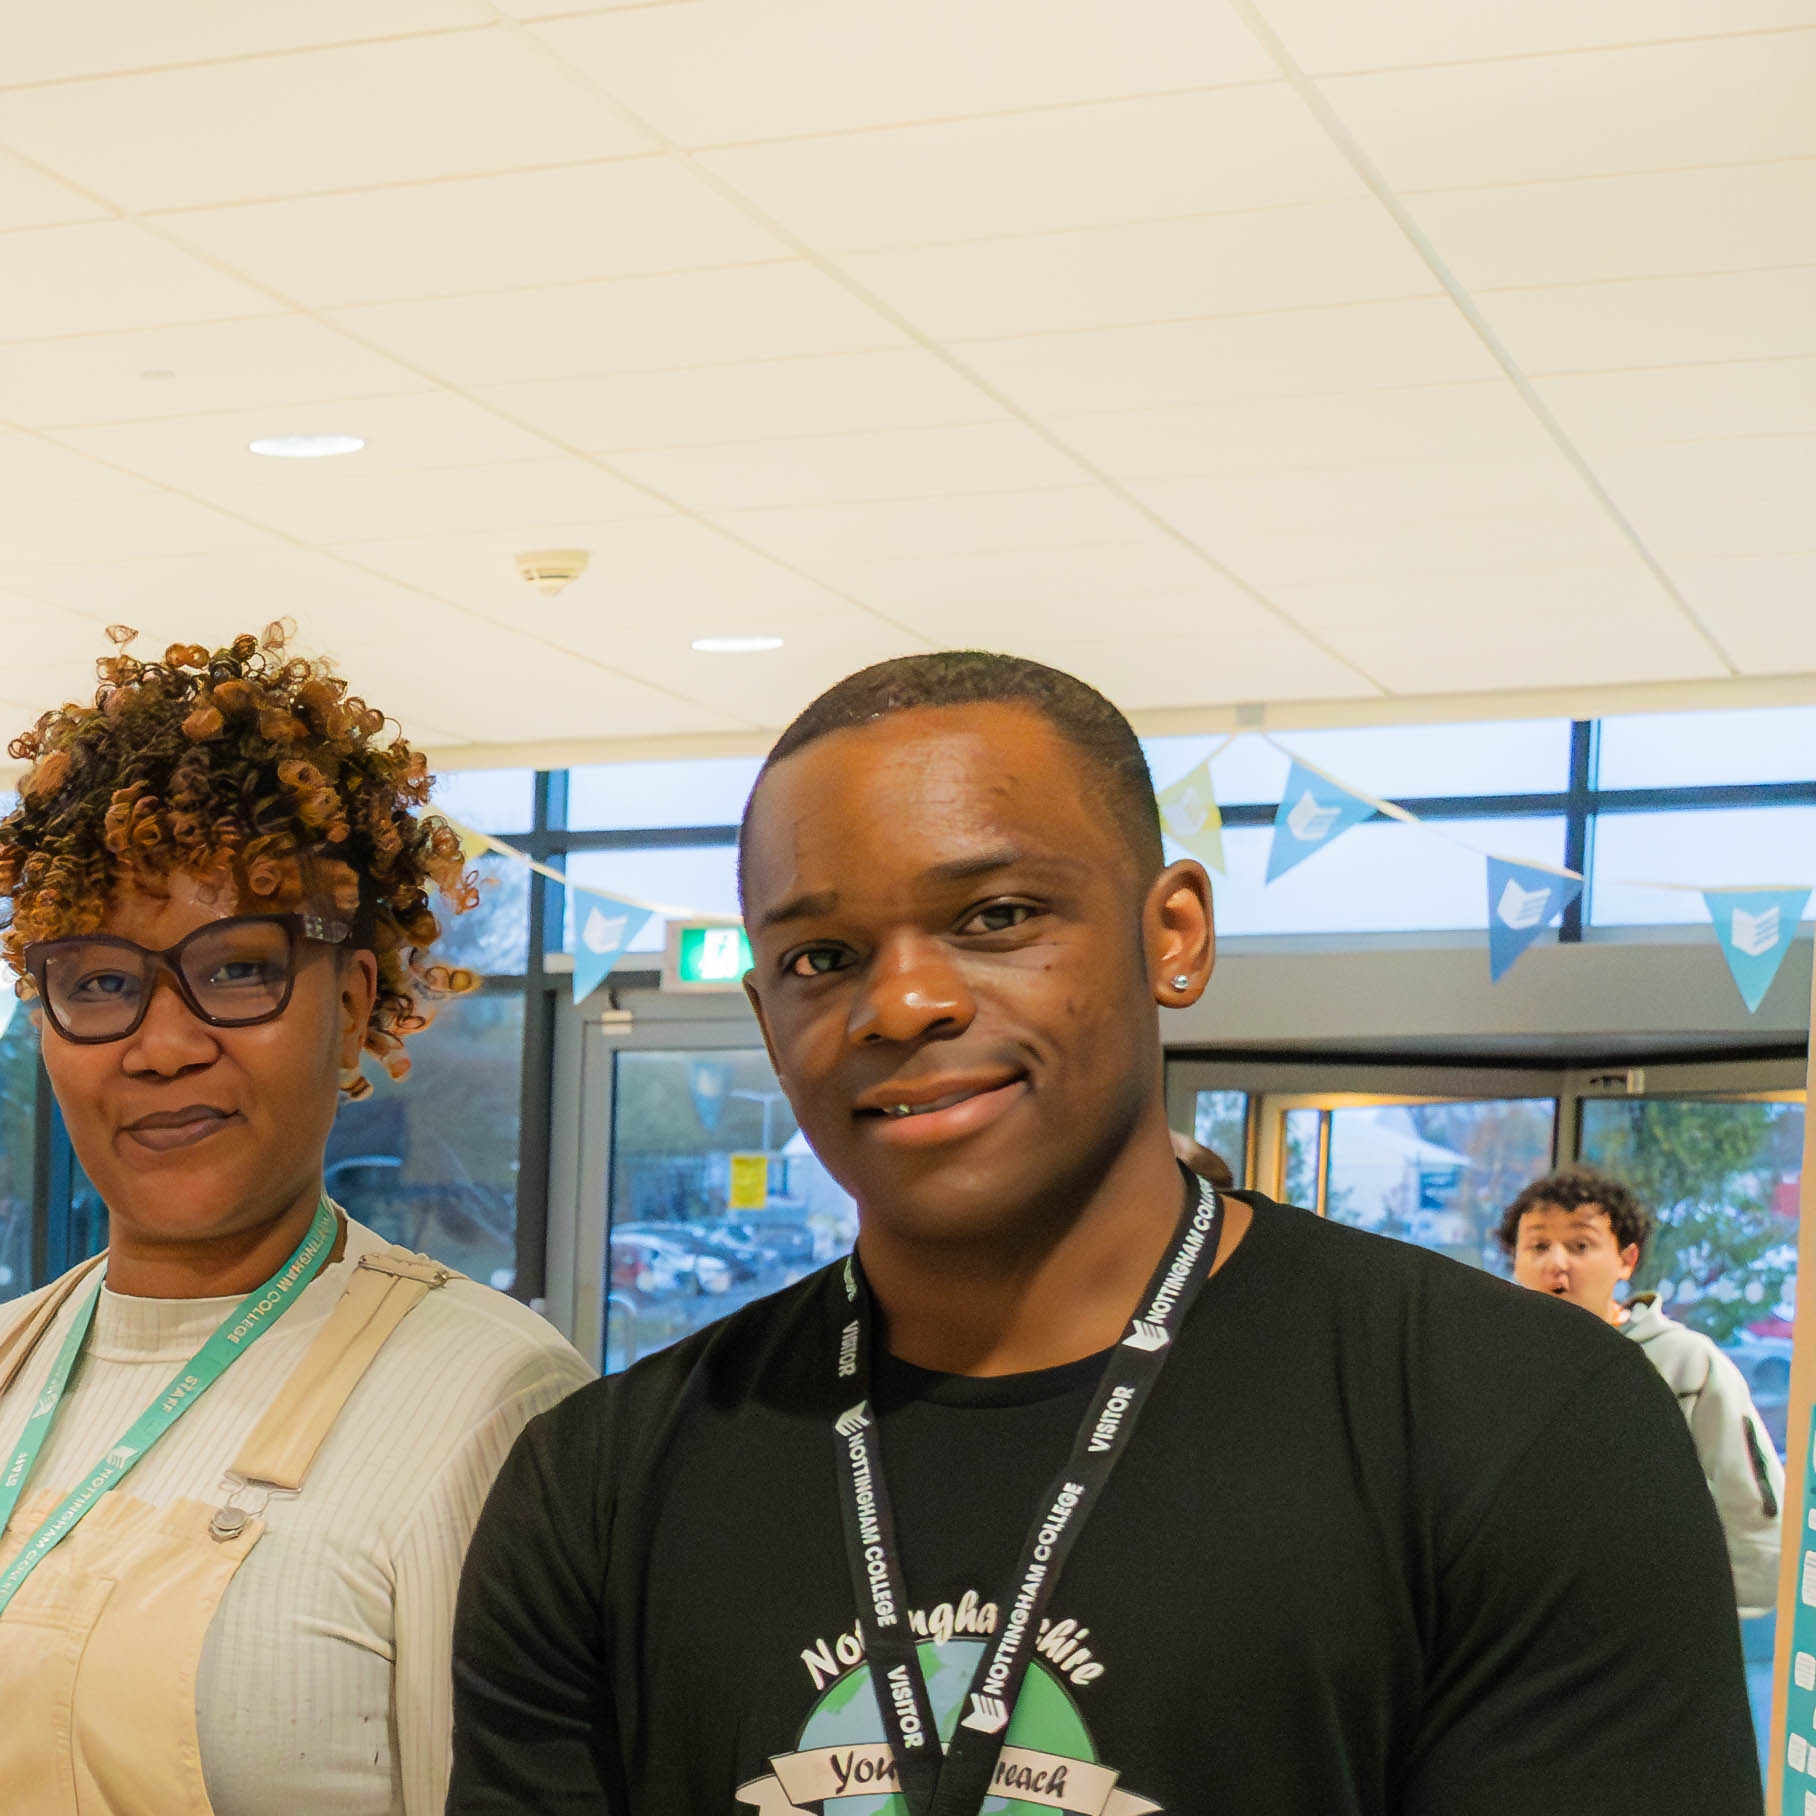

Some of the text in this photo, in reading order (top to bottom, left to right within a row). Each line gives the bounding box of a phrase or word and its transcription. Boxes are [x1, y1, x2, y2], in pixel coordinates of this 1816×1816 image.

[226, 1290, 281, 1344] COLLEGE
[1145, 1228, 1206, 1325] NOTTINGHAM
[838, 1320, 859, 1378] VISITOR
[161, 1375, 199, 1413] STAFF
[1087, 1385, 1136, 1453] VISITOR
[35, 1468, 113, 1549] NOTTINGHAM
[848, 1432, 898, 1628] NOTTINGHAM COLLEGE
[982, 1481, 1086, 1695] NOTTINGHAM COLLEGE
[886, 1664, 926, 1749] VISITOR
